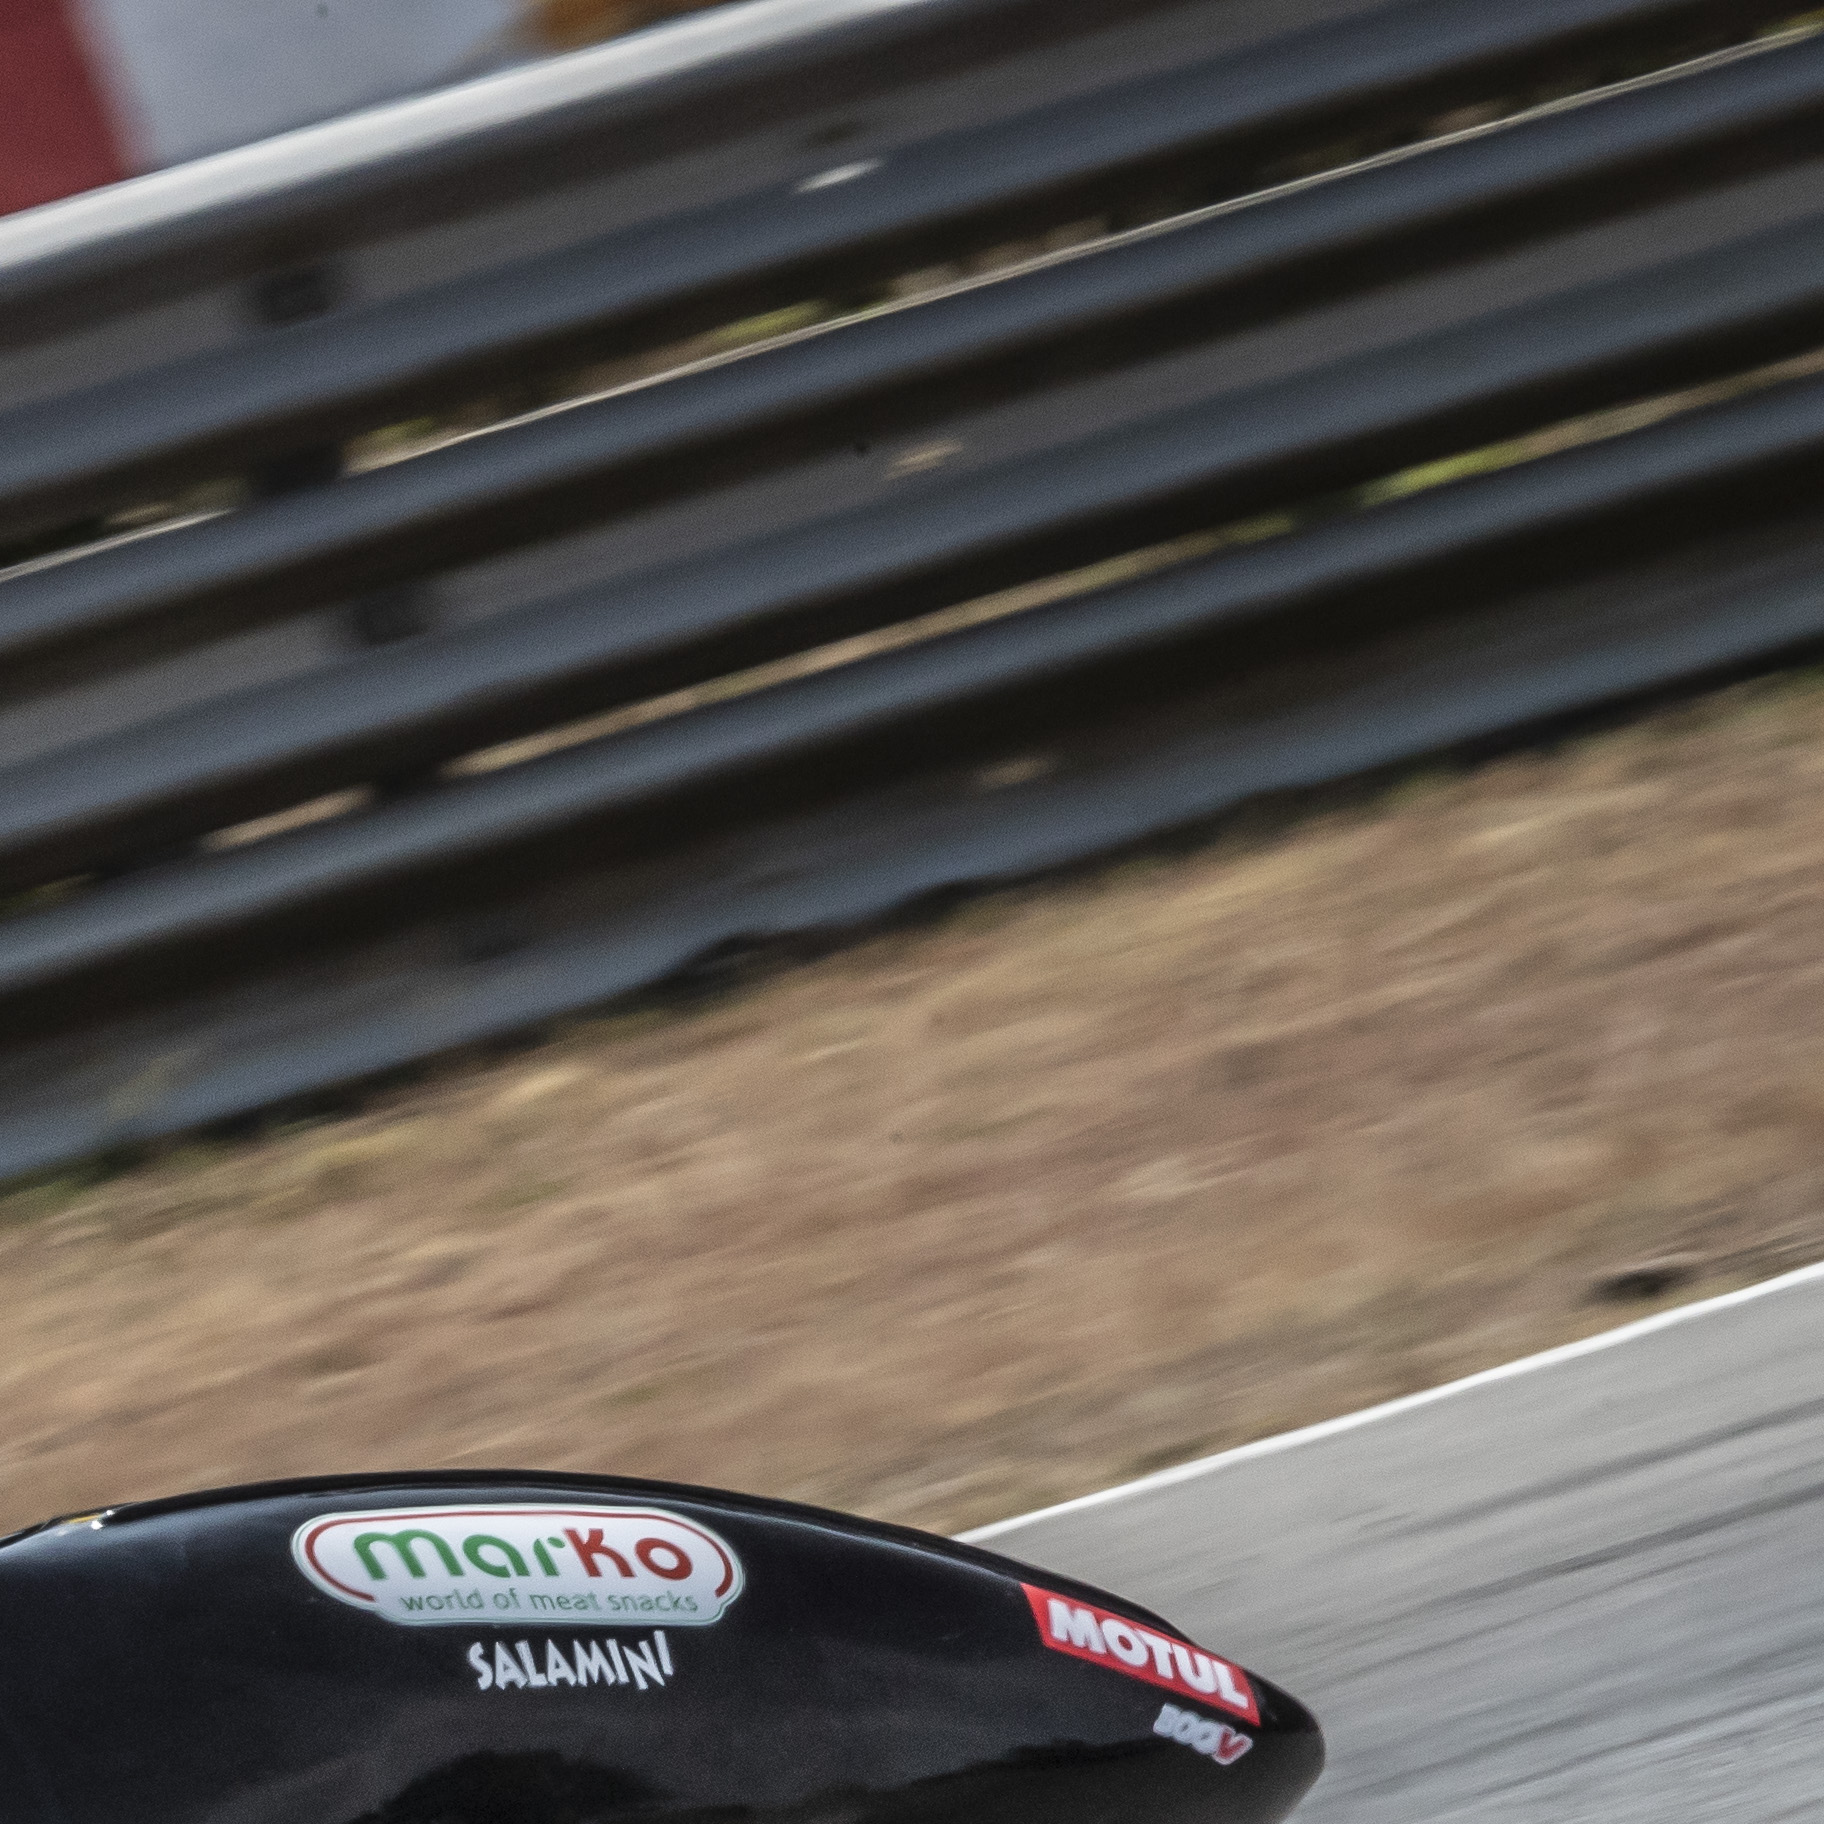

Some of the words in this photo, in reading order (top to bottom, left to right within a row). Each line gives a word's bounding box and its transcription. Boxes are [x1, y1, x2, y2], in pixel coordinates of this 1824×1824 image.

[401, 1586, 484, 1611] world
[494, 1586, 523, 1611] of
[530, 1588, 602, 1612] meat
[607, 1589, 699, 1613] snacks
[467, 1629, 675, 1691] SALAMINI
[1047, 1598, 1249, 1709] MOTUL
